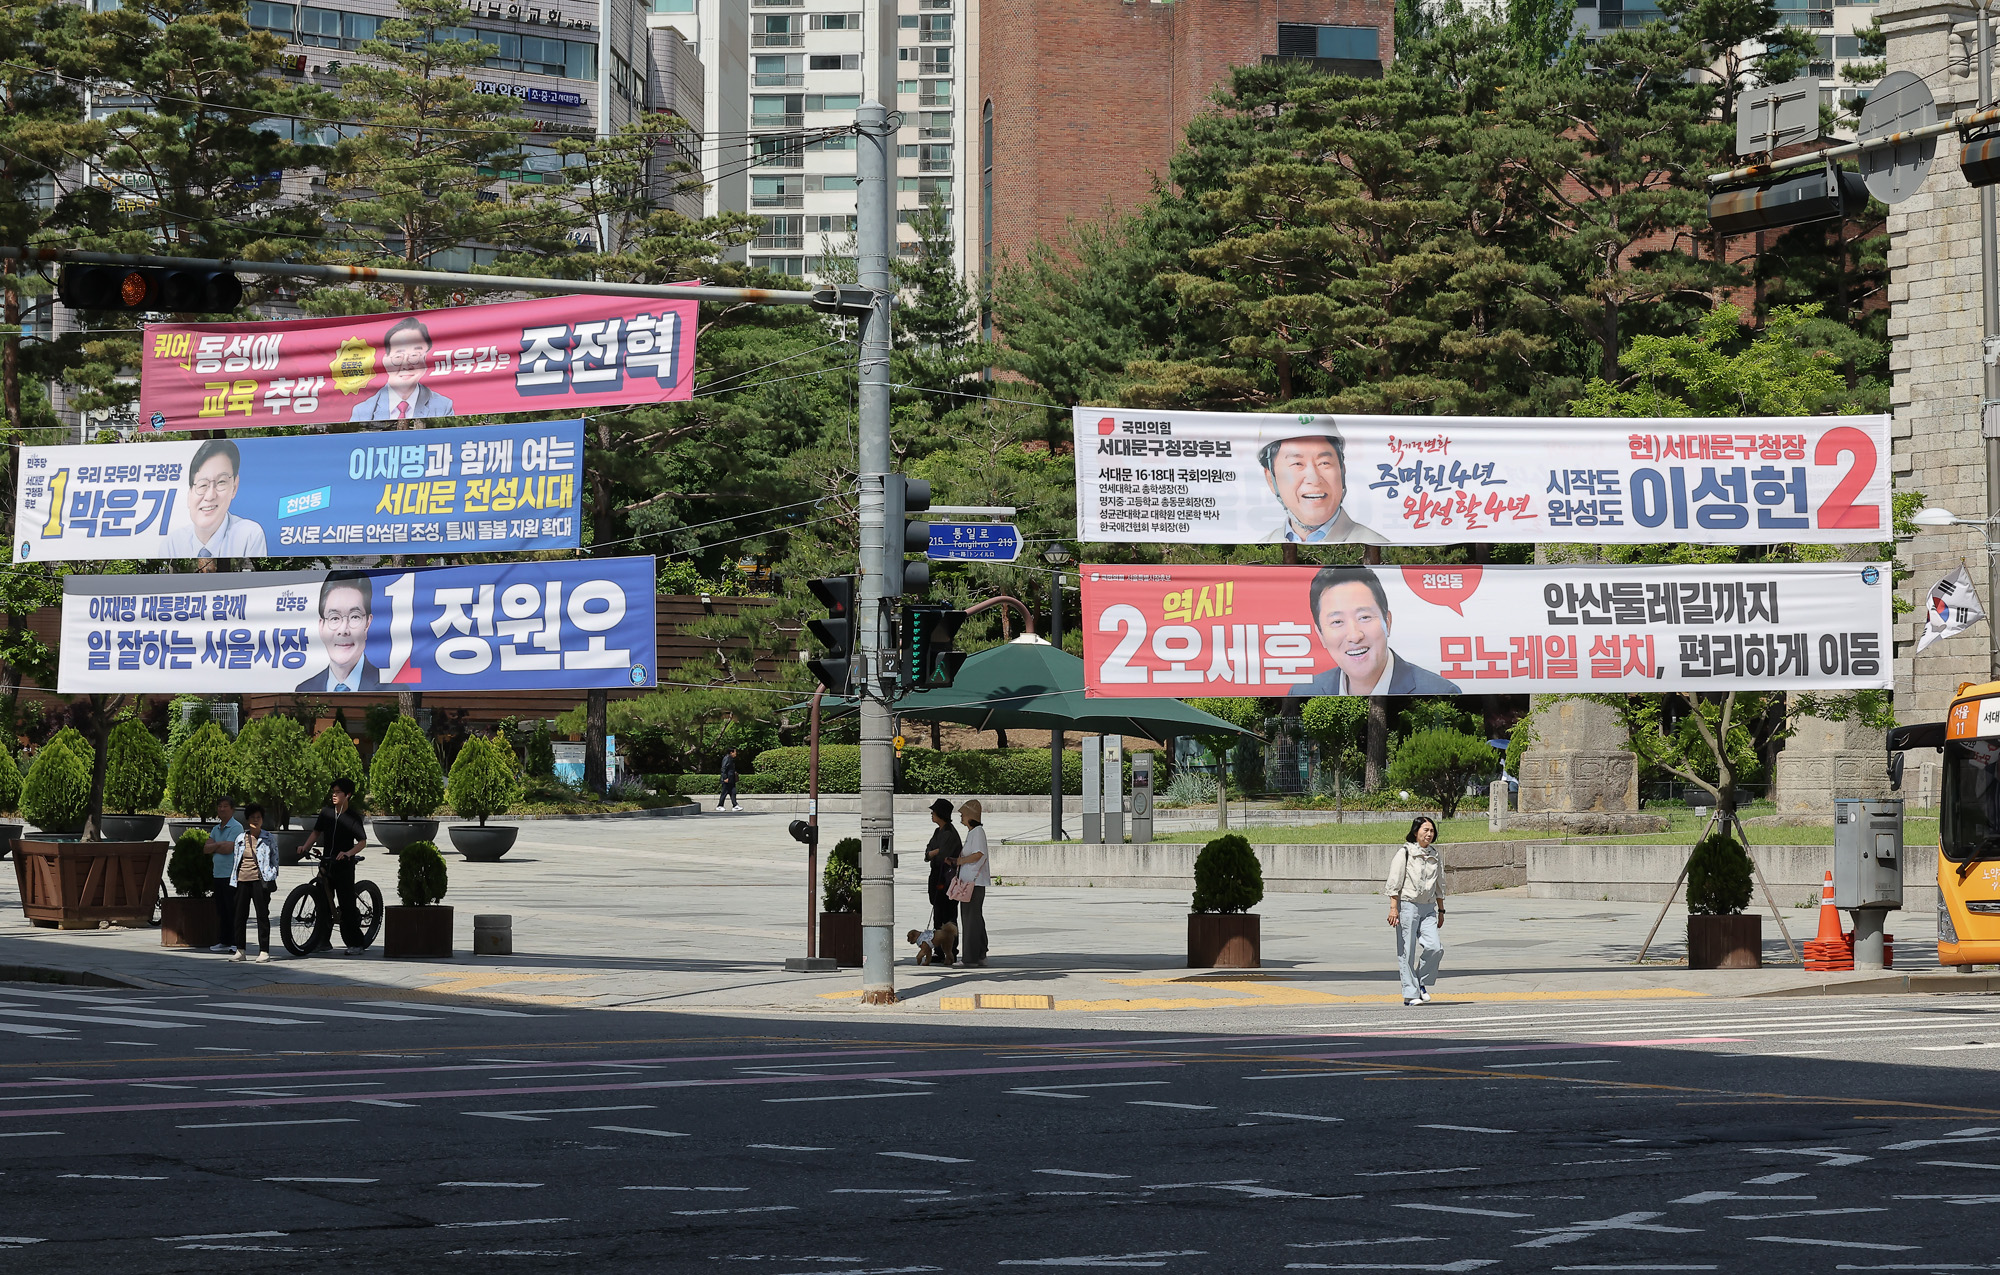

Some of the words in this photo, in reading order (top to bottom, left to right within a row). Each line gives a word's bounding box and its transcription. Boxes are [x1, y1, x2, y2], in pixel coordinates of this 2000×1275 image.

[153, 333, 191, 358] 퀴어
[195, 333, 284, 374] 동성애
[429, 345, 511, 376] 교육감은
[515, 311, 680, 391] 조전혁
[198, 380, 259, 418] 교육
[263, 376, 326, 415] 추방
[1122, 421, 1172, 435] 국민의힘
[350, 442, 452, 480] 이재명과
[460, 439, 513, 476] 함께
[521, 436, 575, 471] 여는
[1098, 438, 1232, 458] 서대문구청장후보
[1628, 433, 1807, 462] 현)서대문구청장
[27, 458, 47, 468] 민주당
[77, 465, 102, 484] 우리
[104, 464, 141, 483] 모두의
[143, 463, 183, 482] 구청장
[1098, 467, 1133, 482] 서대문
[1177, 468, 1236, 483] 국회의원(전)
[1099, 483, 1140, 494] 연세대학교
[1546, 469, 1620, 496] 시작도
[1813, 425, 1880, 530] 2
[25, 487, 43, 498] 구청장
[25, 499, 36, 509] 후보
[41, 468, 70, 539] 1
[286, 491, 323, 514] 천연동
[375, 479, 457, 516] 서대문
[464, 473, 575, 513] 전성시대
[1629, 465, 1810, 530] 이성헌
[68, 488, 178, 538] 박운기
[1099, 509, 1149, 520] 성균관대학교
[1150, 510, 1176, 521] 대학원
[1177, 510, 1202, 520] 언론학
[1203, 510, 1220, 520] 박사
[1548, 499, 1624, 526] 완성도
[279, 524, 320, 545] 경사로
[322, 523, 364, 544] 스마트
[366, 522, 409, 543] 안심길
[410, 522, 444, 543] 조성,
[445, 520, 476, 541] 틈새
[477, 519, 508, 540] 돌봄
[510, 518, 539, 539] 지원
[541, 516, 572, 537] 확대
[929, 536, 944, 546] 215
[952, 527, 990, 540] 통일로
[1099, 522, 1150, 533] 한국애견협회
[953, 540, 990, 549] Tongil-ro
[998, 537, 1013, 547] 219
[1422, 573, 1463, 590] 천연동
[89, 595, 138, 622] 이재명
[140, 595, 207, 622] 대통령과
[212, 594, 248, 621] 함께
[276, 597, 308, 611] 민주당
[1161, 580, 1235, 623] 역시!
[1543, 581, 1779, 626] 안산둘레길까지
[378, 572, 422, 684] 1
[429, 579, 631, 675] 정원오
[87, 629, 112, 671] 일
[117, 629, 197, 671] 잘하는
[200, 627, 309, 670] 서울시장
[1098, 603, 1149, 685] 2
[1151, 621, 1315, 685] 오세훈
[1439, 634, 1579, 680] 모노레일
[1588, 634, 1665, 680] 설치,
[1678, 633, 1809, 678] 편리하게
[1819, 632, 1880, 676] 이동
[1954, 705, 1970, 719] 서울
[1983, 710, 2000, 724] 서대
[1955, 721, 1965, 736] 11
[1982, 867, 2000, 880] 노약
